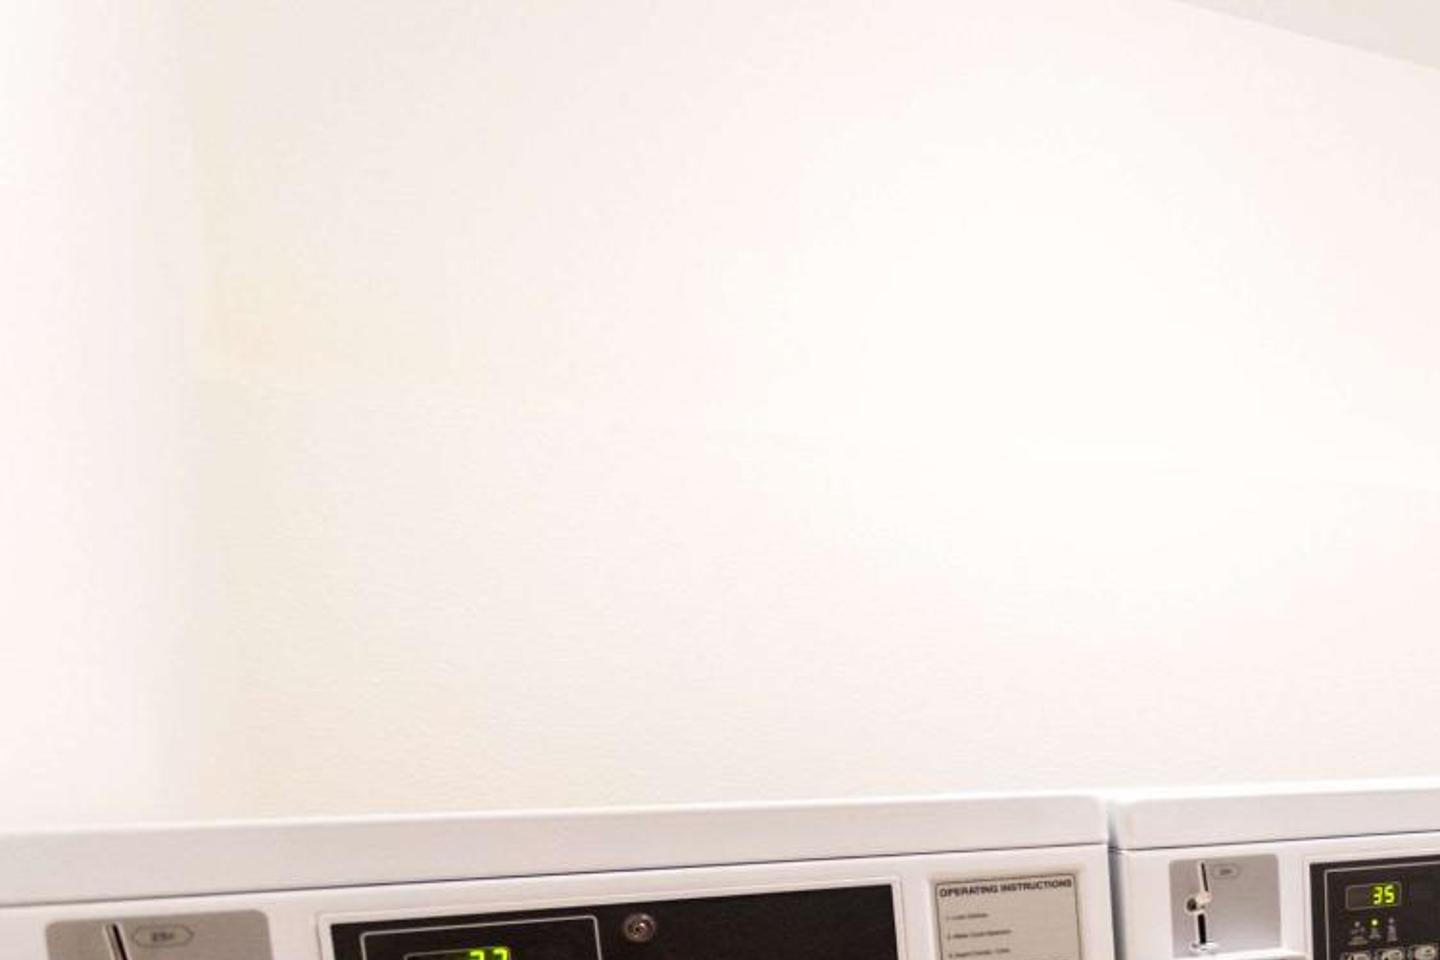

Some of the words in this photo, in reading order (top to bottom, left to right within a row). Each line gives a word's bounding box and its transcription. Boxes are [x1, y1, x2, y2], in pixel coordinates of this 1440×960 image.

[939, 885, 999, 898] OPERATING
[1000, 879, 1072, 892] INSTRUCTIONS
[1372, 884, 1395, 905] 35
